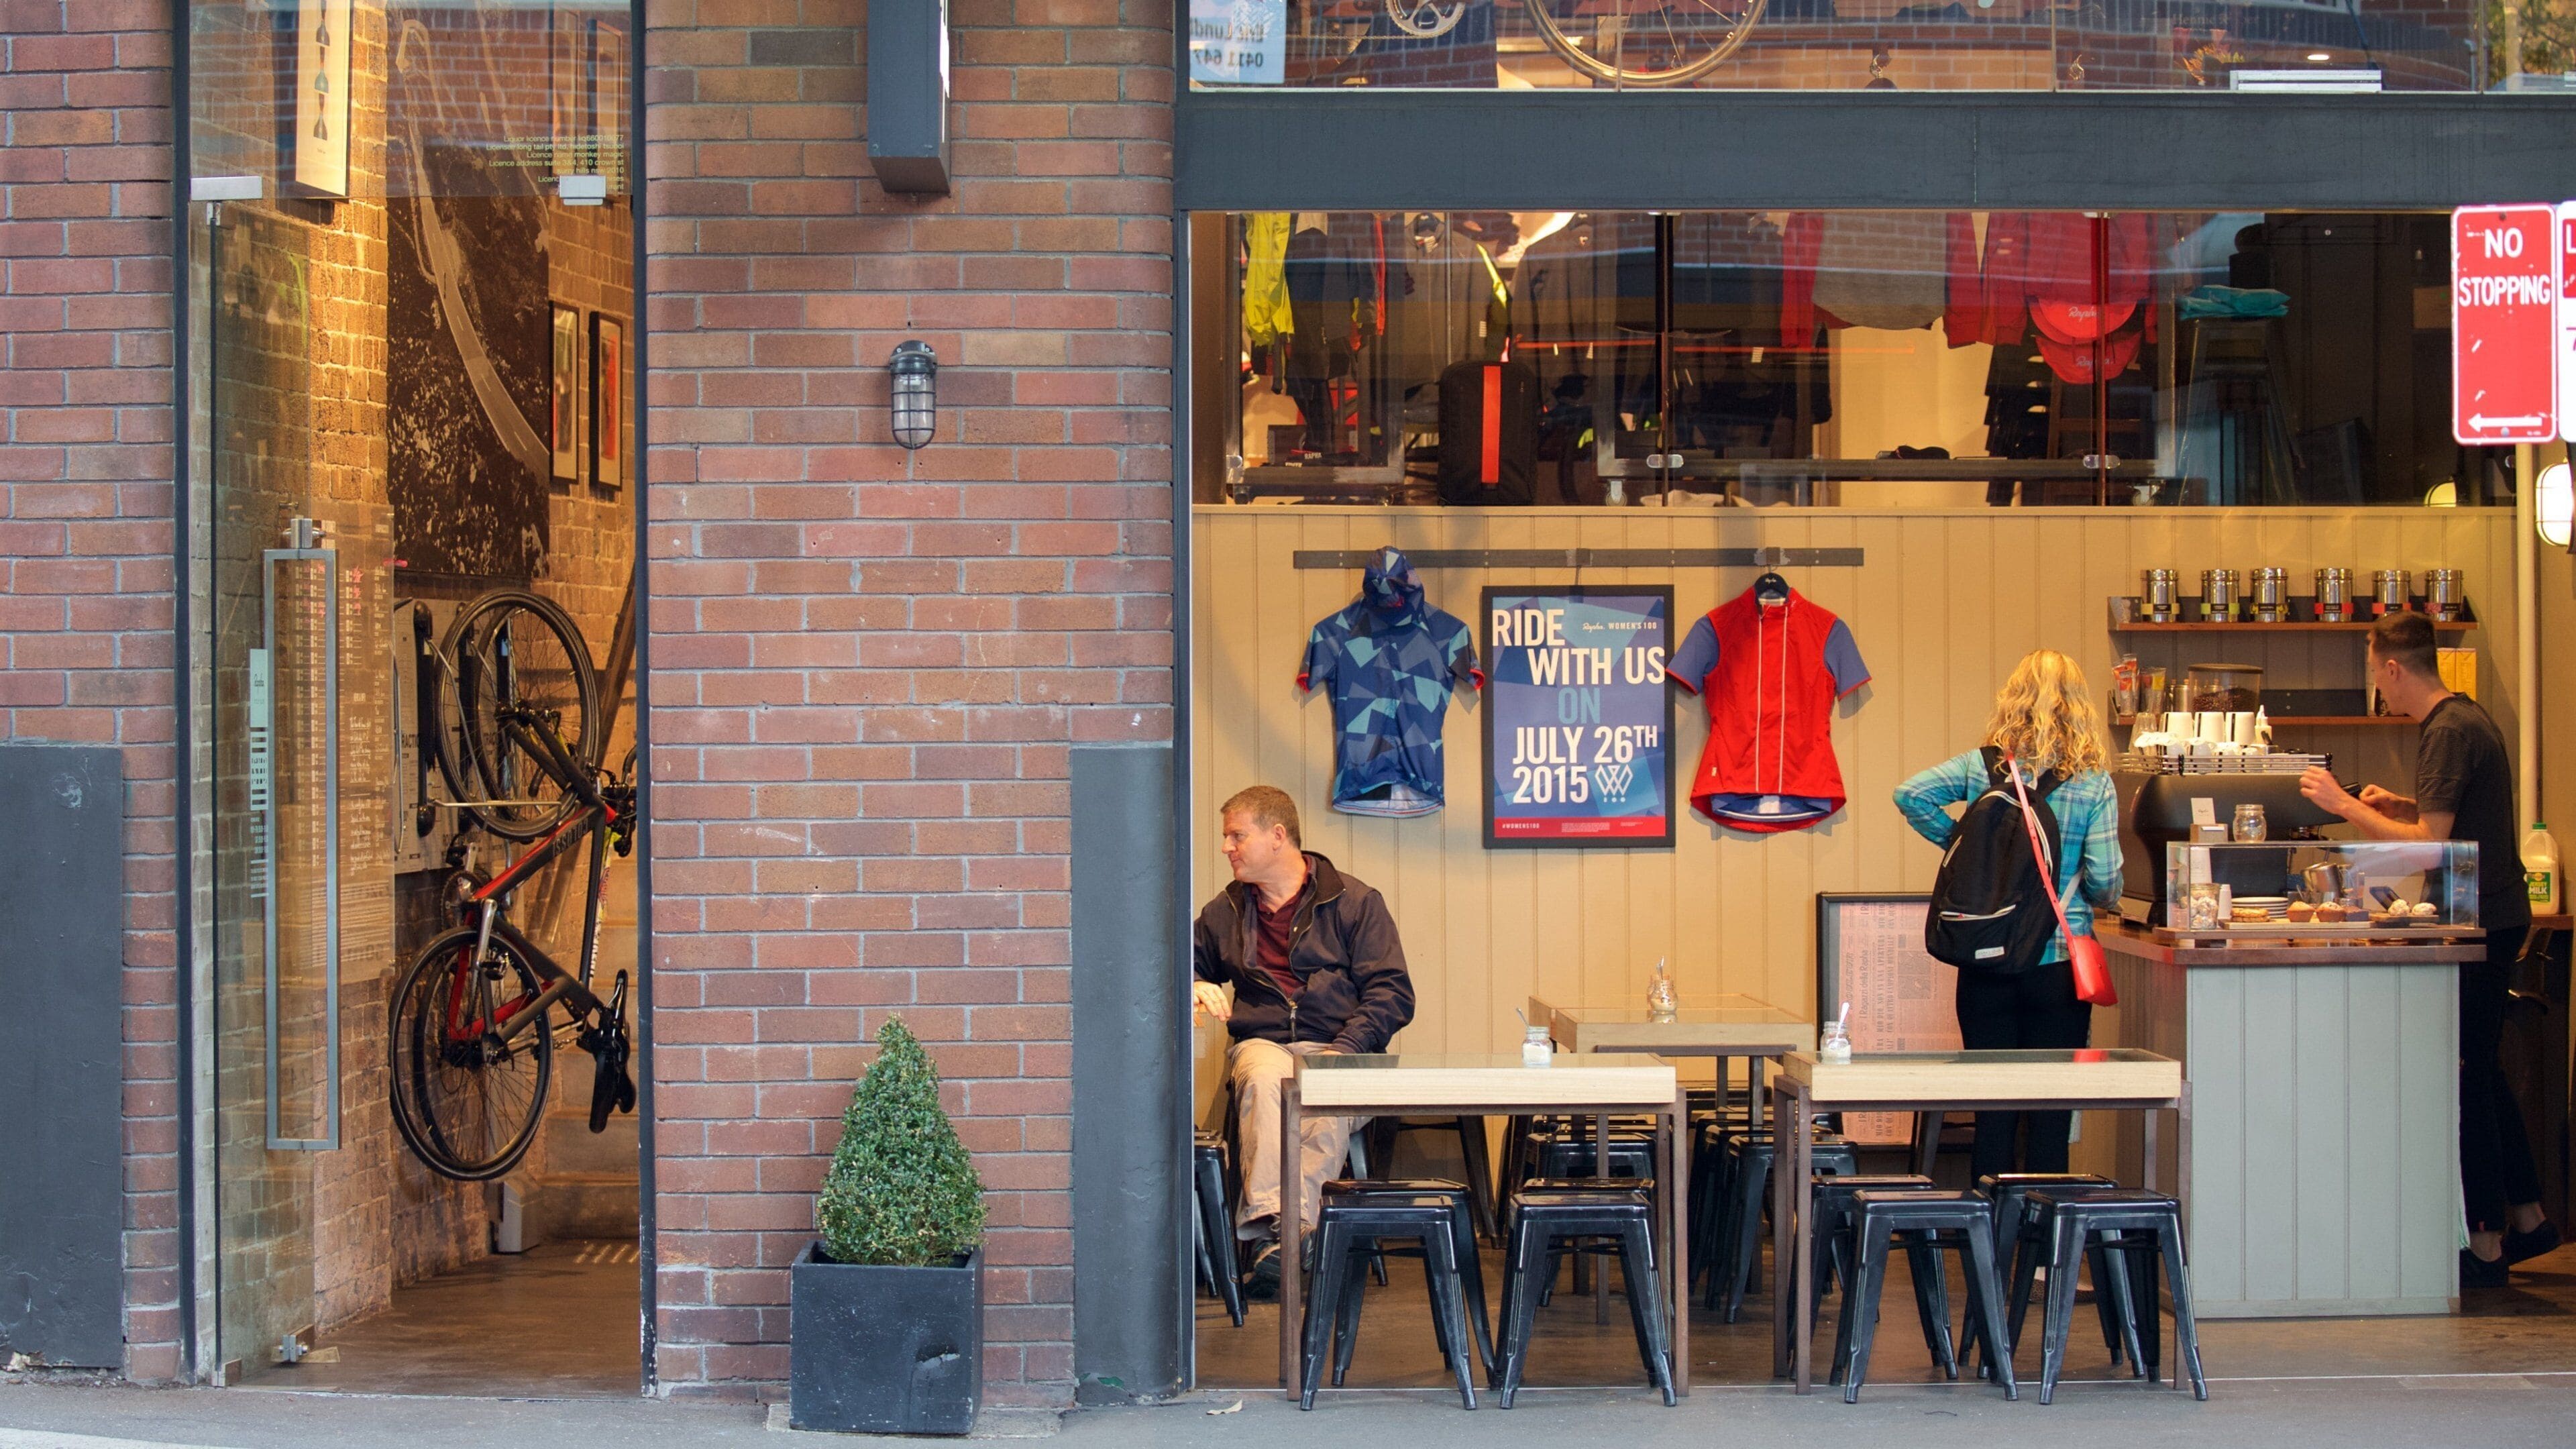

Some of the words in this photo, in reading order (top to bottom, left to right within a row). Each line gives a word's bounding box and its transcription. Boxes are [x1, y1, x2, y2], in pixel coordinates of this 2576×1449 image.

[2484, 227, 2524, 258] NO
[2458, 274, 2551, 307] STOPPING
[1492, 608, 1565, 647] RIDE
[1527, 647, 1611, 686] WITH
[1625, 646, 1665, 685] US
[1558, 687, 1601, 724] ON
[1512, 727, 1584, 765] JULY
[1594, 724, 1658, 764] 26TH
[1512, 765, 1589, 804] 2015
[1860, 950, 1870, 971] Rapha
[1860, 971, 1868, 988] della
[1860, 989, 1870, 1015] Ragazzi
